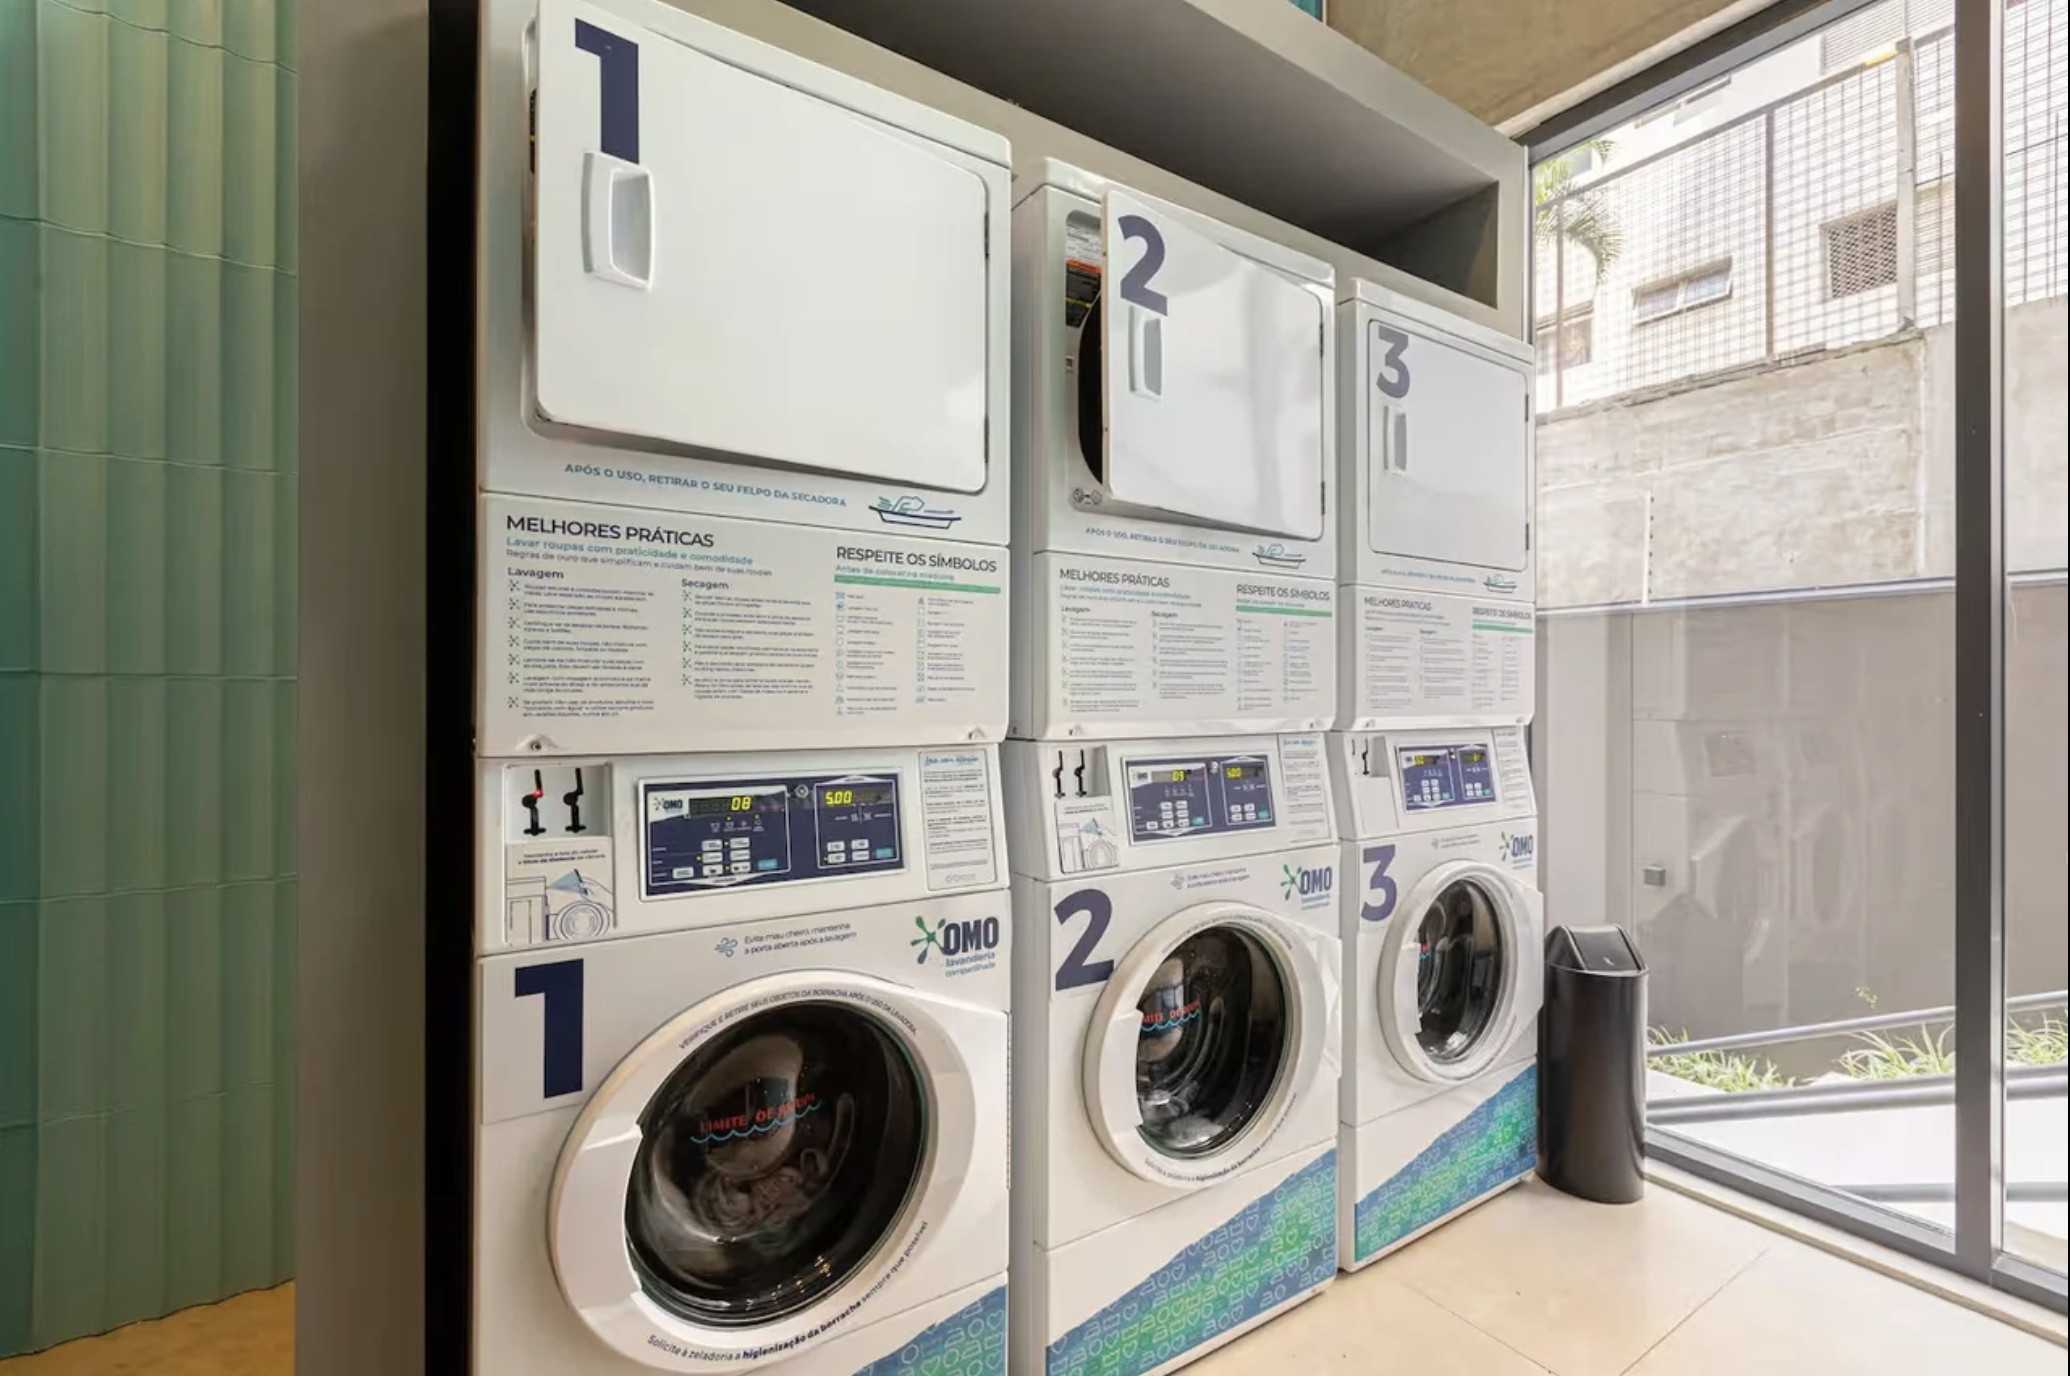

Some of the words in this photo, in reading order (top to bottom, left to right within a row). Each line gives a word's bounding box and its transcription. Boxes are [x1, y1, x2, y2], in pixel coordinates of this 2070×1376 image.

[575, 17, 639, 165] 1
[1118, 215, 1168, 316] 2
[1376, 325, 1411, 399] 3
[565, 463, 600, 476] APÓS
[604, 468, 613, 478] O
[617, 470, 646, 483] USO,
[649, 474, 698, 489] RETIRAR
[701, 481, 709, 489] O
[713, 482, 734, 493] SEU
[737, 485, 771, 497] FELPO
[774, 490, 789, 499] DA
[791, 492, 847, 507] SECADORA
[507, 514, 621, 539] MELHORES
[626, 526, 714, 548] PRÁTICAS
[506, 537, 540, 547] Lavar
[544, 541, 584, 552] roupas
[587, 545, 613, 554] com
[615, 546, 678, 559] praticidade
[680, 552, 687, 560] e
[690, 554, 753, 565] comodidade
[836, 546, 904, 565] RESPEITE
[906, 552, 926, 566] OS
[929, 552, 997, 573] SÍMBOLOS
[507, 567, 564, 579] Lavagem
[681, 578, 730, 590] Secagem
[1060, 568, 1120, 585] MELHORES
[1122, 572, 1170, 588] PRÁTICAS
[1236, 584, 1276, 598] RESPEITE
[1277, 587, 1289, 598] OS
[662, 800, 683, 810] OMO
[731, 796, 752, 811] 08
[1512, 834, 1533, 857] OMO
[1299, 866, 1332, 895] OMO
[1361, 844, 1398, 922] 3
[744, 935, 764, 945] Evite
[942, 916, 999, 956] OMO
[1054, 889, 1114, 991] 2
[946, 952, 995, 967] lavanderia
[515, 961, 584, 1098] 1
[699, 1114, 748, 1133] LIMITE
[647, 1333, 681, 1355] Solicite
[682, 1346, 688, 1357] à
[688, 1350, 733, 1361] zeladoria
[742, 1335, 806, 1360] higienização
[807, 1328, 820, 1339] da
[820, 1300, 861, 1331] borracha
[861, 1272, 892, 1302] sempre
[890, 1256, 904, 1274] que
